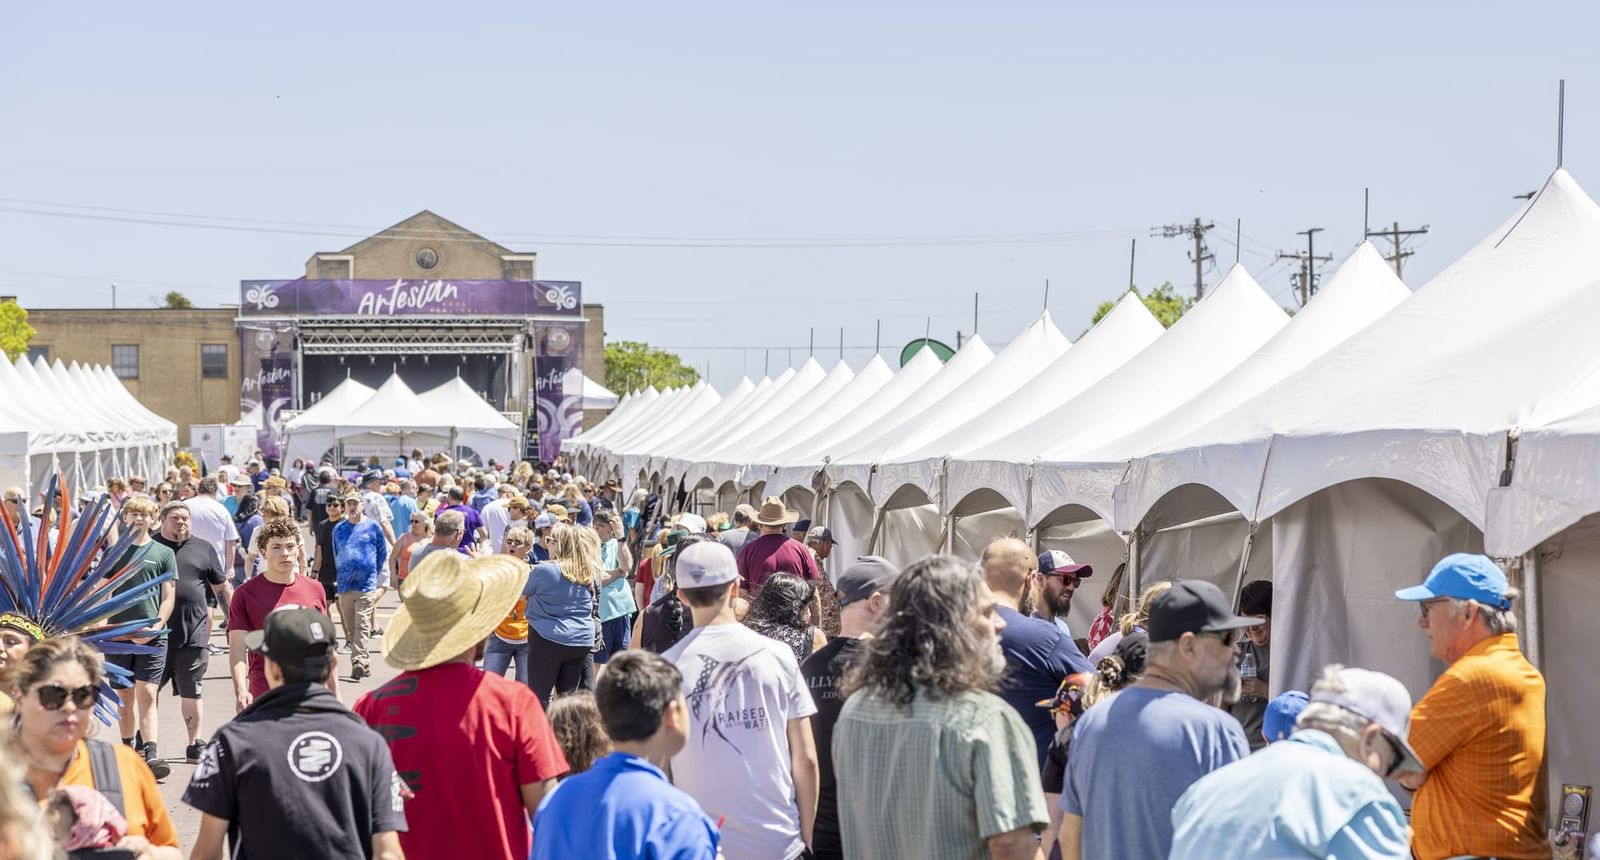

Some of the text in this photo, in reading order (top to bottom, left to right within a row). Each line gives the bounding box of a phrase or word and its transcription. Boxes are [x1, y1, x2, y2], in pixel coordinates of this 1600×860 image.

[357, 278, 458, 315] Artesian
[241, 367, 291, 391] Artesian
[718, 707, 766, 723] RAISED
